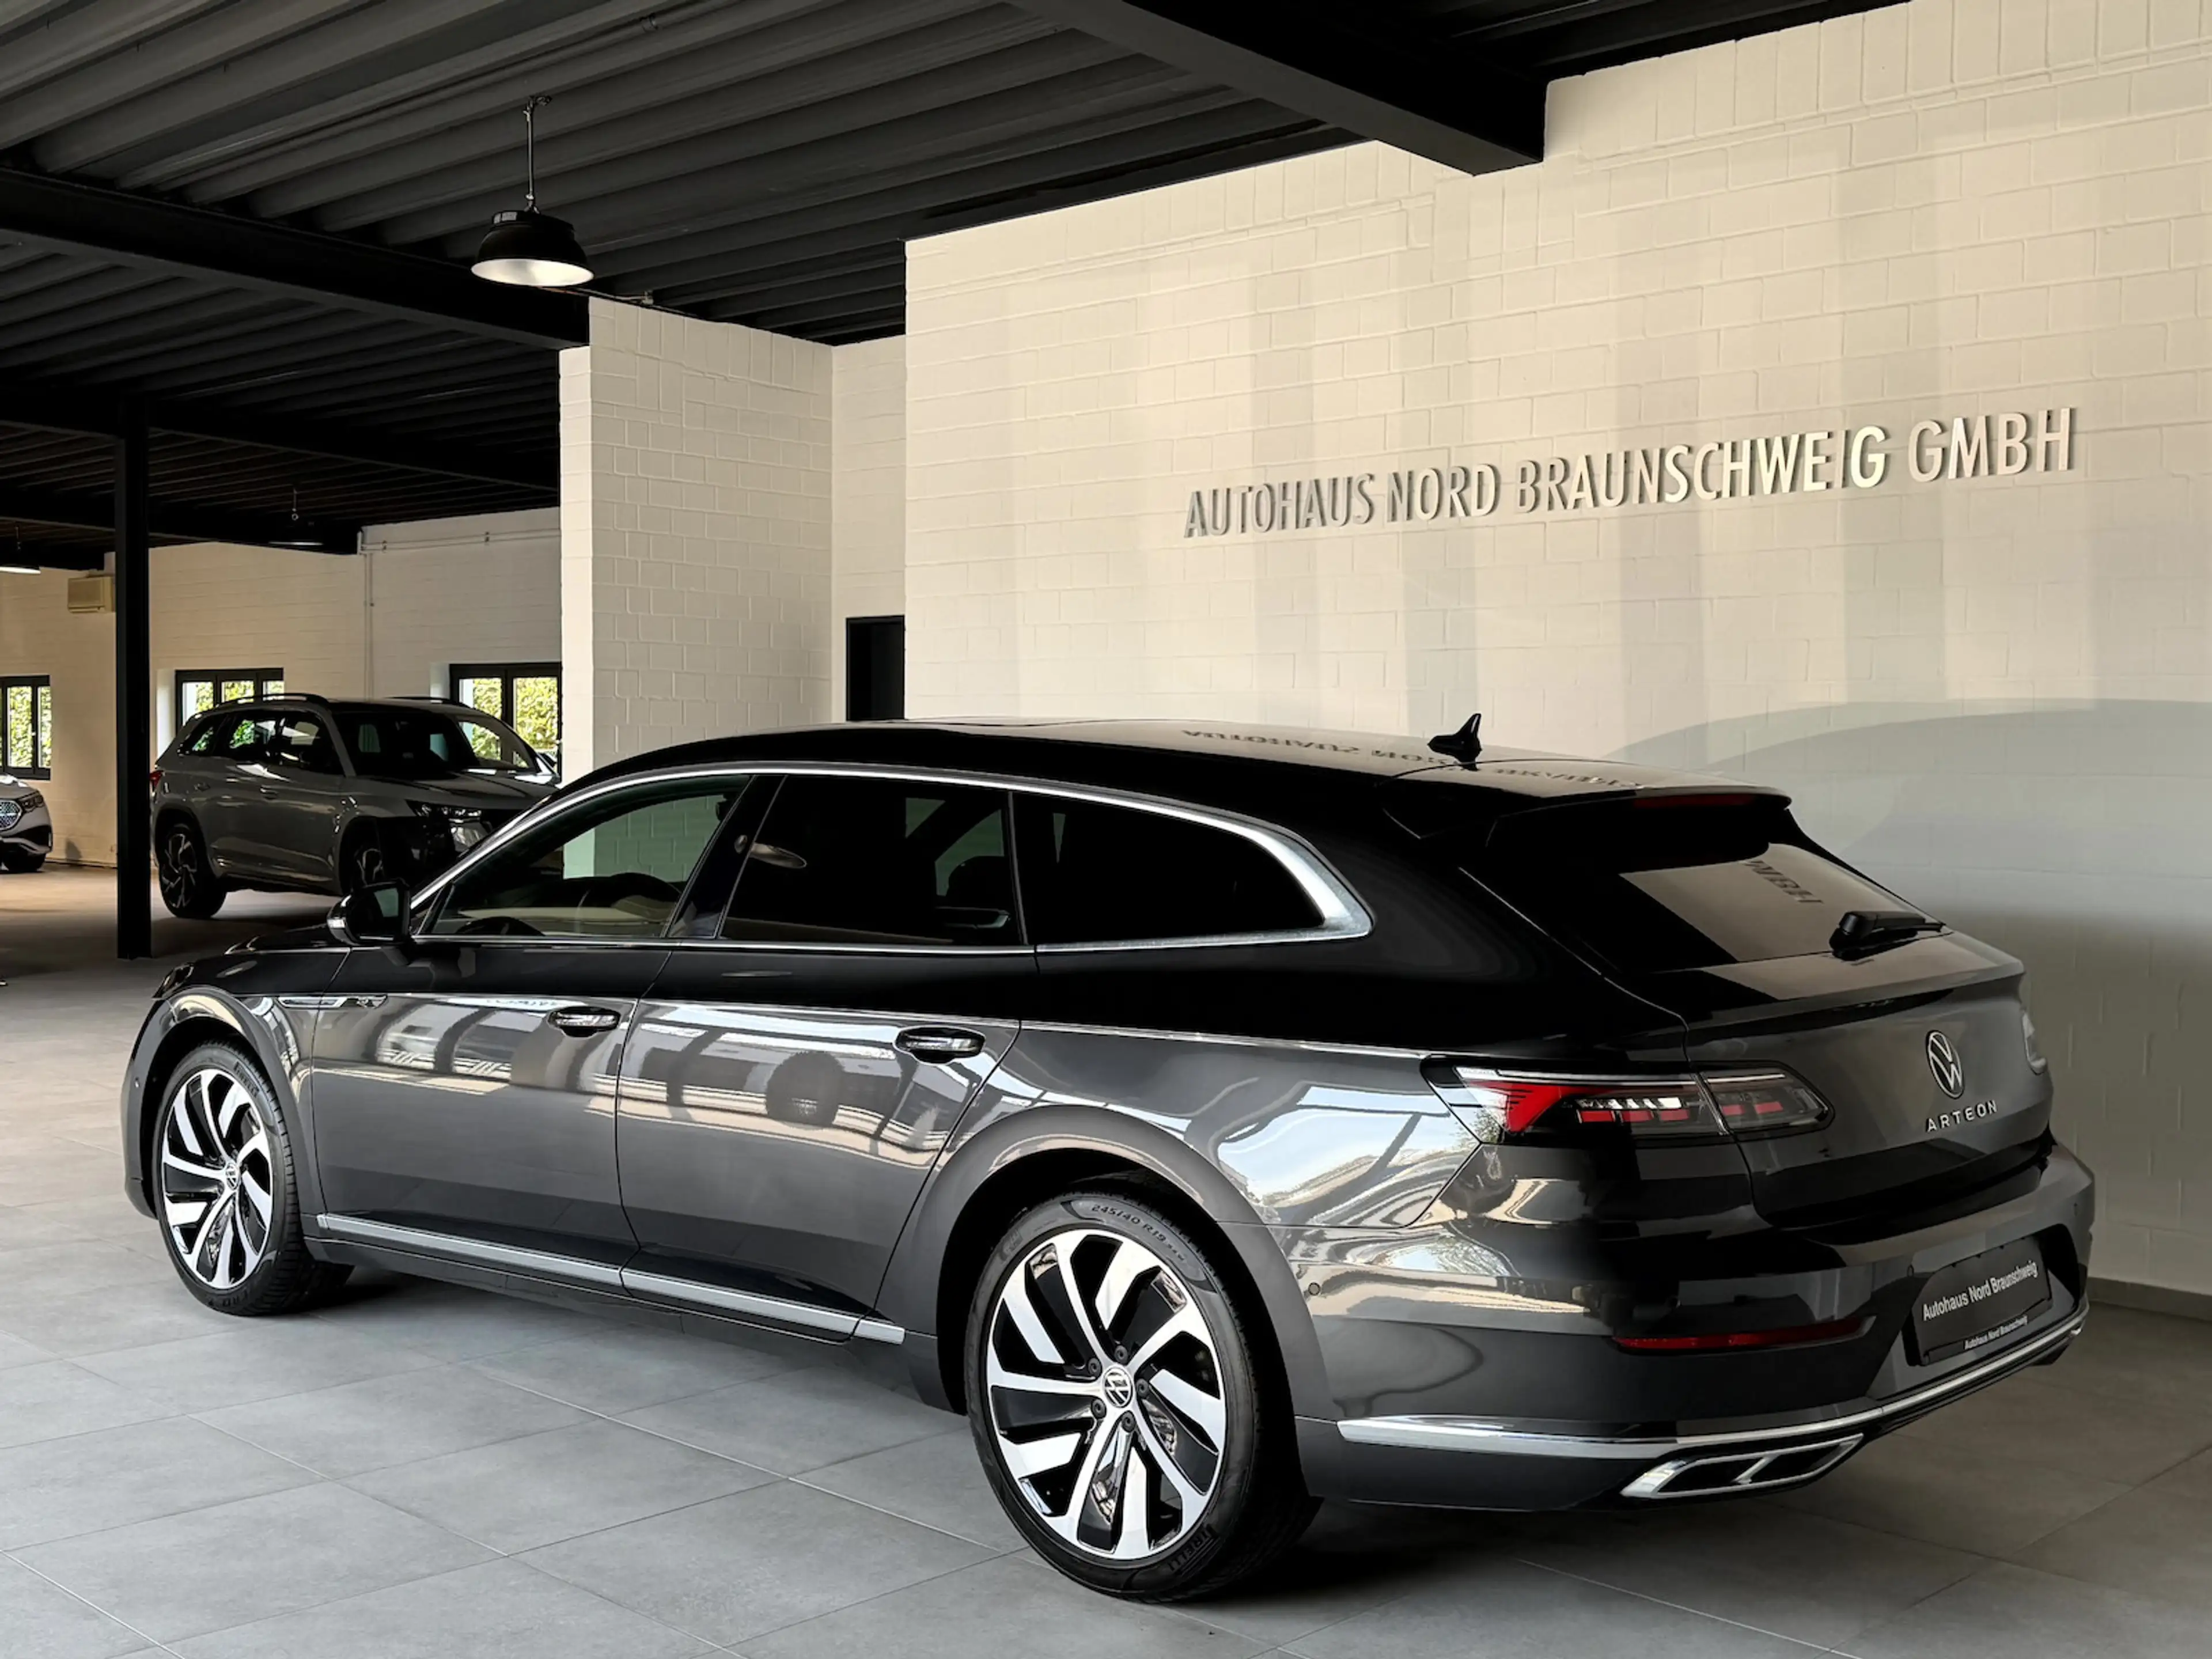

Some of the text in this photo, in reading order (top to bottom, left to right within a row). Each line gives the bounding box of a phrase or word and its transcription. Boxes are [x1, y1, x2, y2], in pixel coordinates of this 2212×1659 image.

[1184, 408, 2077, 537] AUTOHAUS NORD BRAUNSCHWEIG GMBH
[1926, 1100, 1998, 1132] ARTEON
[1092, 1205, 1167, 1243] 245/40 R19
[1923, 1293, 1969, 1321] Autohaus
[1968, 1280, 1991, 1303] Nord
